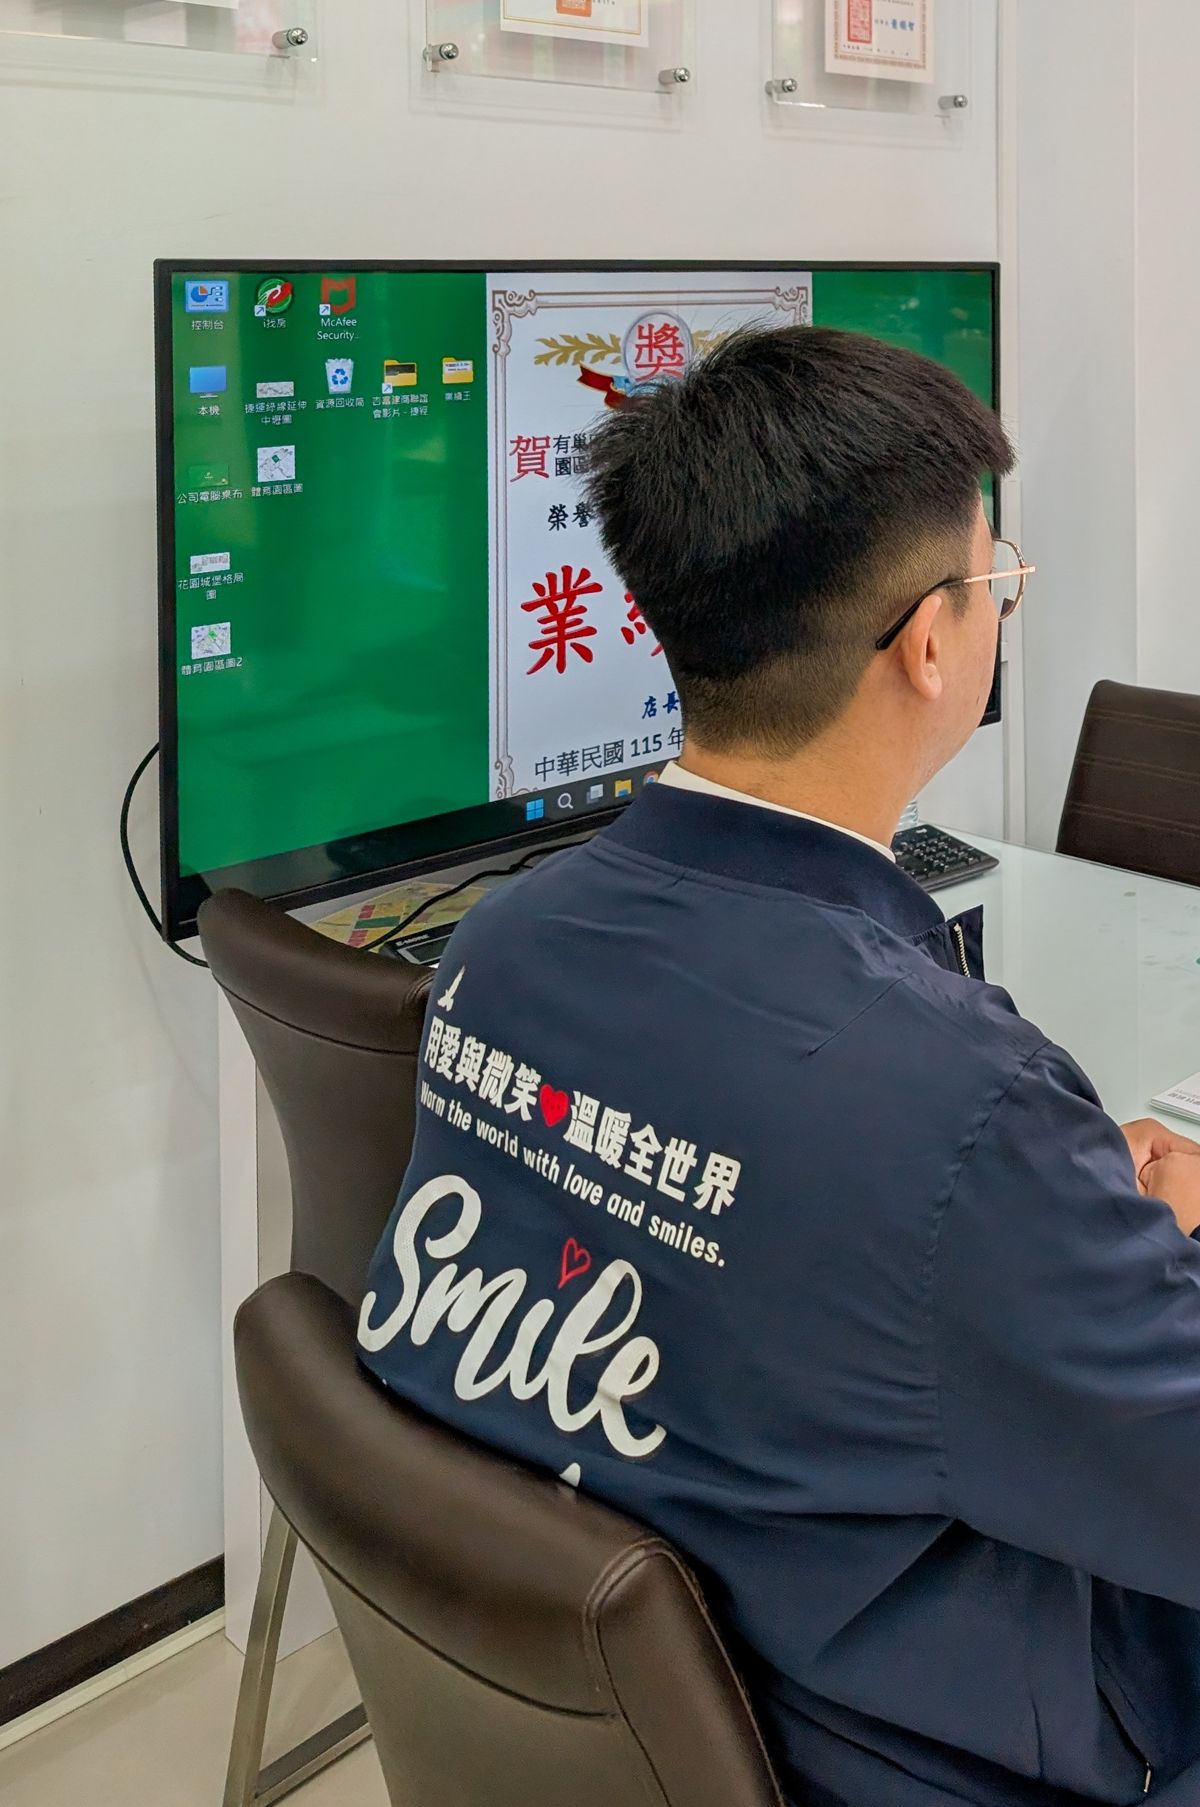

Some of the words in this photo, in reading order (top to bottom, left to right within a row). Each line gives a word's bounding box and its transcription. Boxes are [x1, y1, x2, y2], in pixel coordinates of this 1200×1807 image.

[192, 319, 224, 331] 控制台
[320, 317, 357, 327] McAfee
[634, 323, 685, 382] 獎
[509, 435, 551, 482] 賀
[553, 433, 596, 455] 有巢
[177, 489, 243, 504] 公司電腦桌布
[642, 690, 680, 719] 店長
[534, 738, 625, 783] 中華民國
[630, 734, 662, 757] 115
[667, 727, 685, 751] 年
[423, 1015, 541, 1123] 用愛與微笑
[563, 1090, 742, 1216] 溫暖全世界
[447, 1099, 471, 1132] the
[476, 1119, 519, 1158] world
[523, 1146, 559, 1184] with
[564, 1166, 603, 1207] love
[606, 1191, 643, 1228] and
[649, 1214, 725, 1267] smiles.
[357, 1175, 666, 1457] Smile
